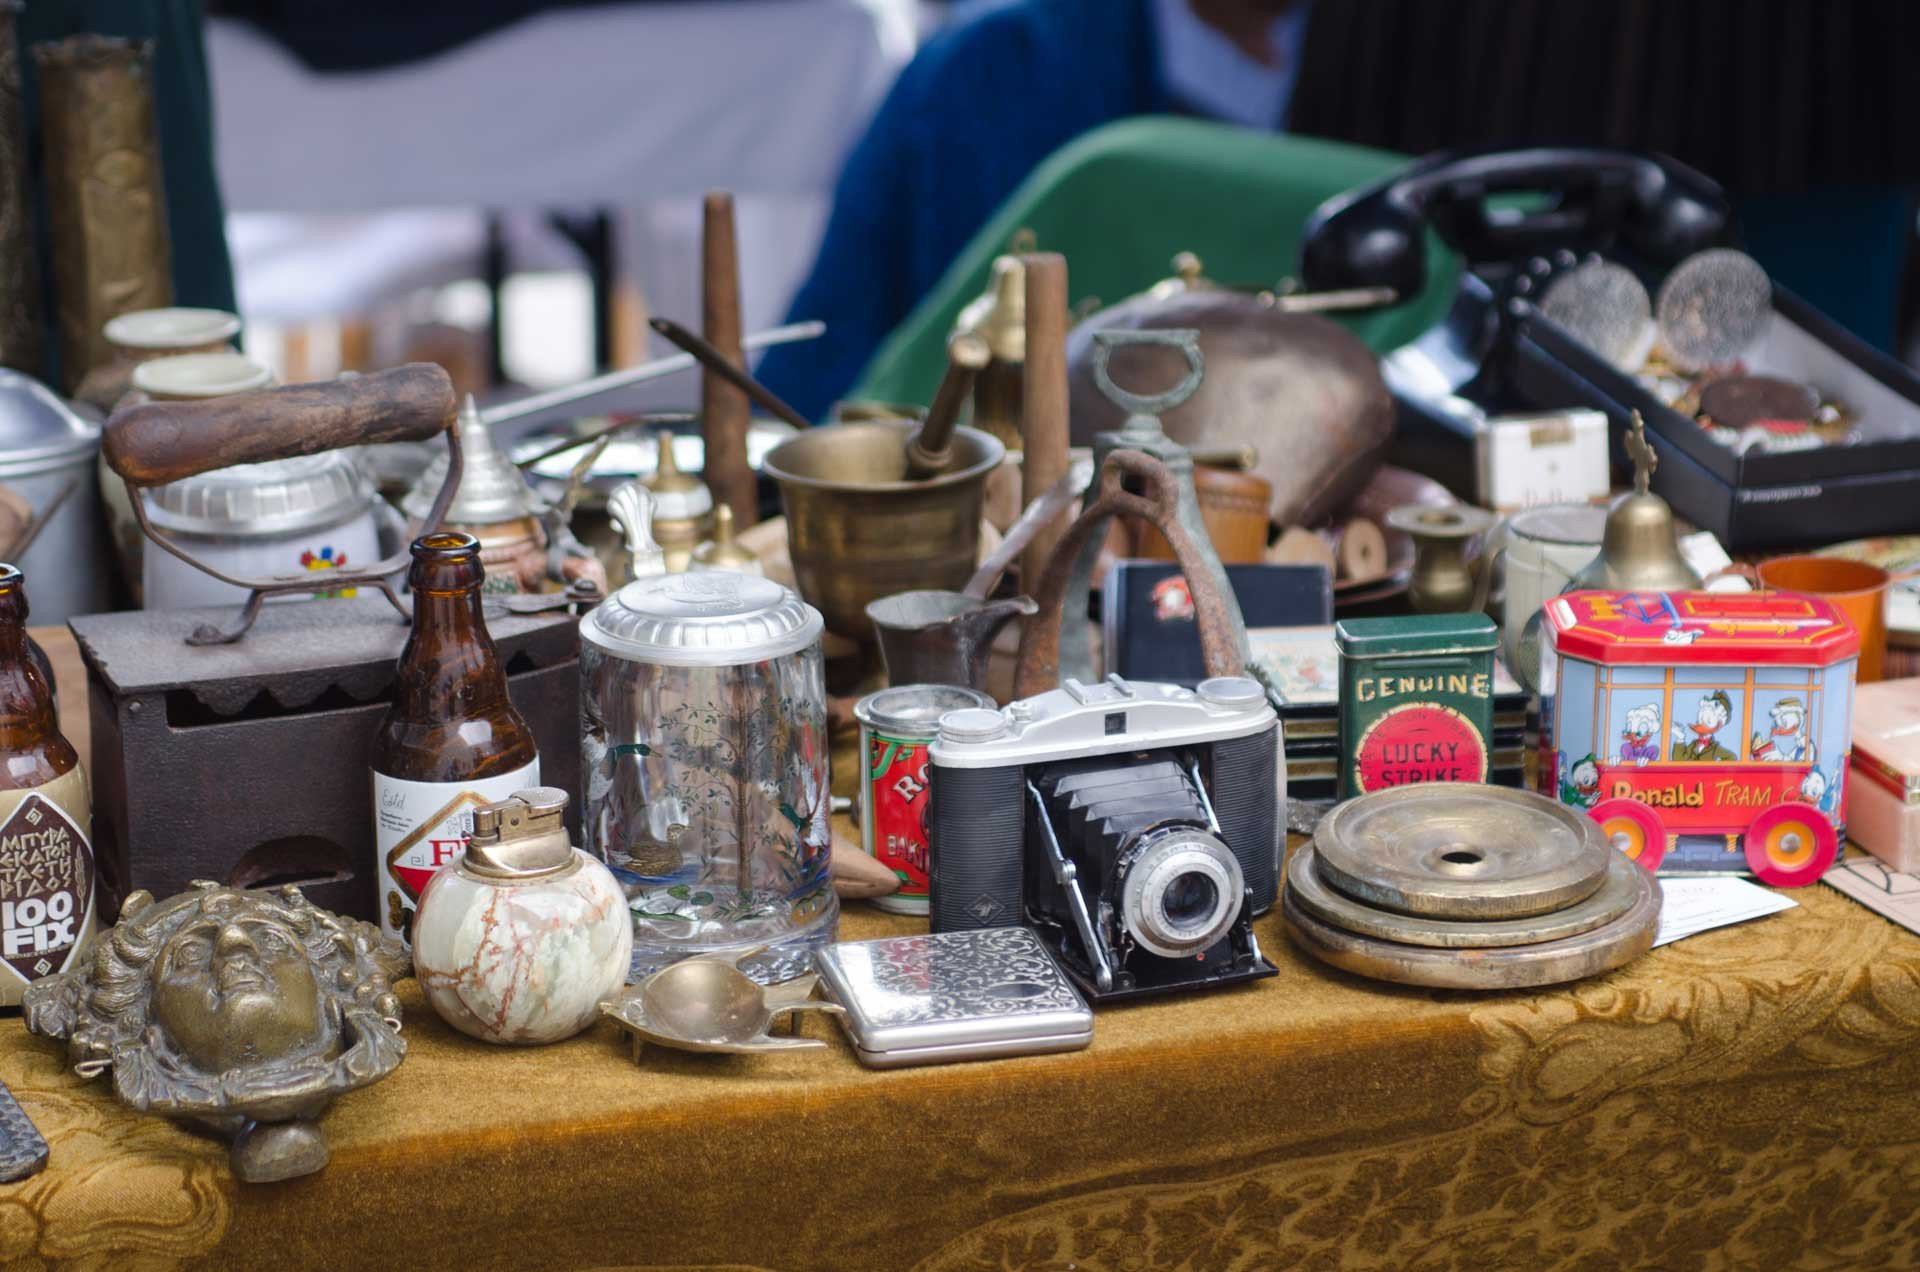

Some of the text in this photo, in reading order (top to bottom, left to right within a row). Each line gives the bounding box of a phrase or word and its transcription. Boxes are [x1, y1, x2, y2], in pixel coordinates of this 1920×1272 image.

[1356, 674, 1489, 702] GENUINE
[1382, 743, 1459, 765] LUCKY
[1612, 780, 1704, 809] Donald
[1715, 779, 1772, 807] TRAM
[429, 838, 471, 867] F
[888, 835, 929, 871] BAKI
[2, 891, 74, 930] 100
[3, 916, 75, 955] FIX
